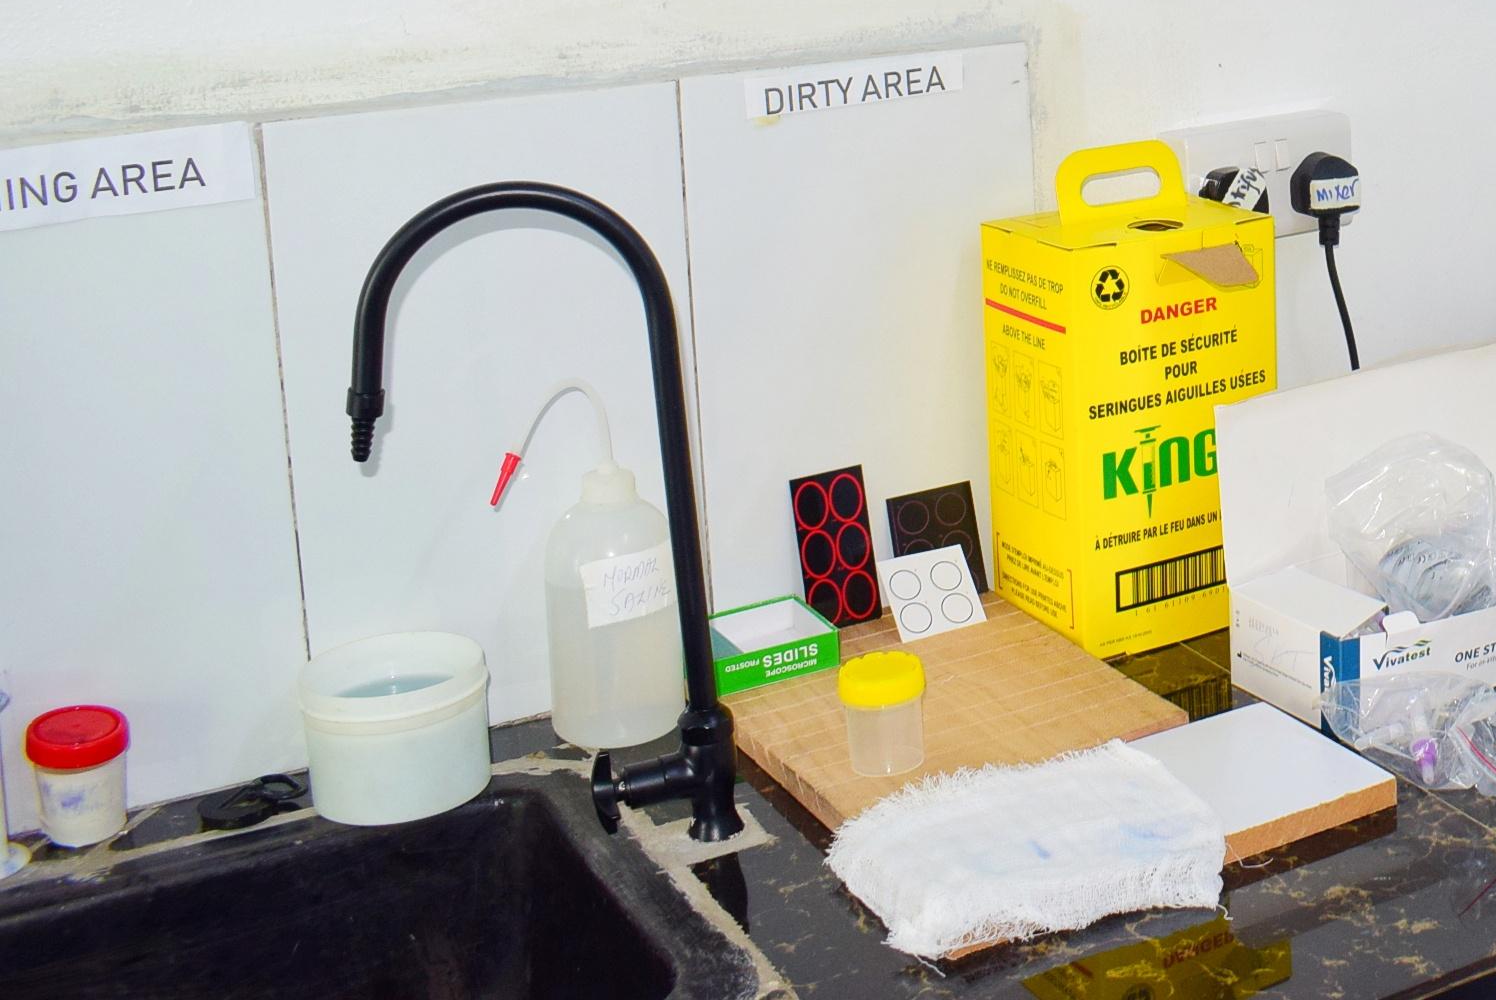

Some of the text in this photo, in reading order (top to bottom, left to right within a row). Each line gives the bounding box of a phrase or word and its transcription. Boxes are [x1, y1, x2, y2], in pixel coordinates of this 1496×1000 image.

[764, 65, 946, 115] DIRTY AREA
[0, 157, 207, 211] ING AREA
[1026, 273, 1038, 287] PAS
[1038, 277, 1046, 290] DE
[1047, 280, 1064, 295] TROP
[1008, 285, 1020, 300] NOT
[1020, 290, 1047, 310] OVERFILL
[1140, 296, 1217, 325] DANGER
[1002, 324, 1046, 350] ABOVE THE LINE
[1161, 341, 1177, 358] DE
[1180, 325, 1238, 354] SÉCURITÉ
[1164, 361, 1198, 380] POUR
[1088, 392, 1162, 420] SERINGUES
[1165, 378, 1227, 405] AIGUILLES
[1103, 530, 1141, 549] DÉTRUIRE
[1143, 526, 1158, 539] PAR
[1159, 524, 1169, 535] LE
[1170, 520, 1184, 533] FEU
[1187, 514, 1206, 528] DANS
[1207, 510, 1218, 523] UN
[725, 643, 818, 673] SLIDES FROSTED
[1372, 645, 1432, 671] Vivatest
[1454, 646, 1480, 663] ONE
[1466, 661, 1478, 671] For
[765, 658, 818, 678] MICROSCOPE
